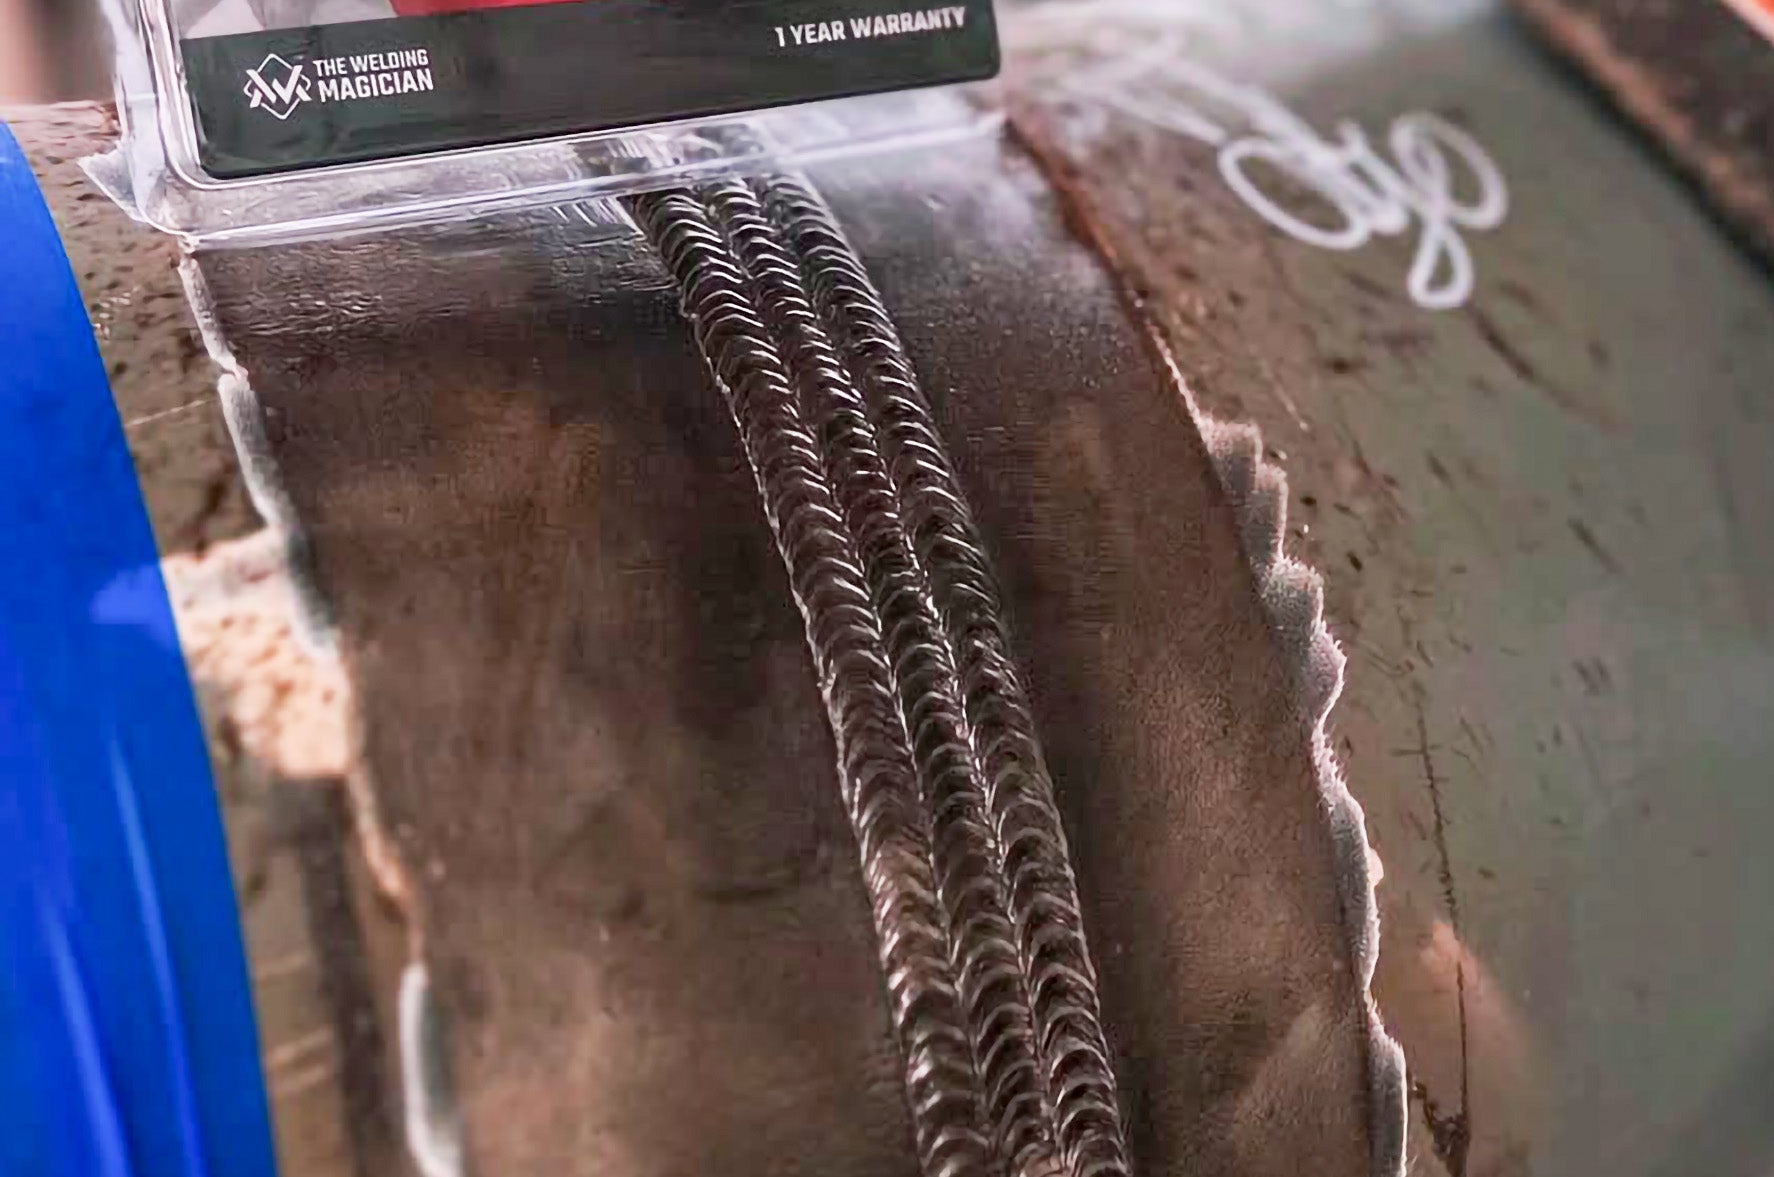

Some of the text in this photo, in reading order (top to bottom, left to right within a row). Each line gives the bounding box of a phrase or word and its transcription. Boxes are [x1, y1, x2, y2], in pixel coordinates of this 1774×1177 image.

[775, 6, 967, 47] 1 YEAR WARRANTY
[313, 49, 429, 77] THE WELDING
[318, 69, 434, 102] MAGICIAN
